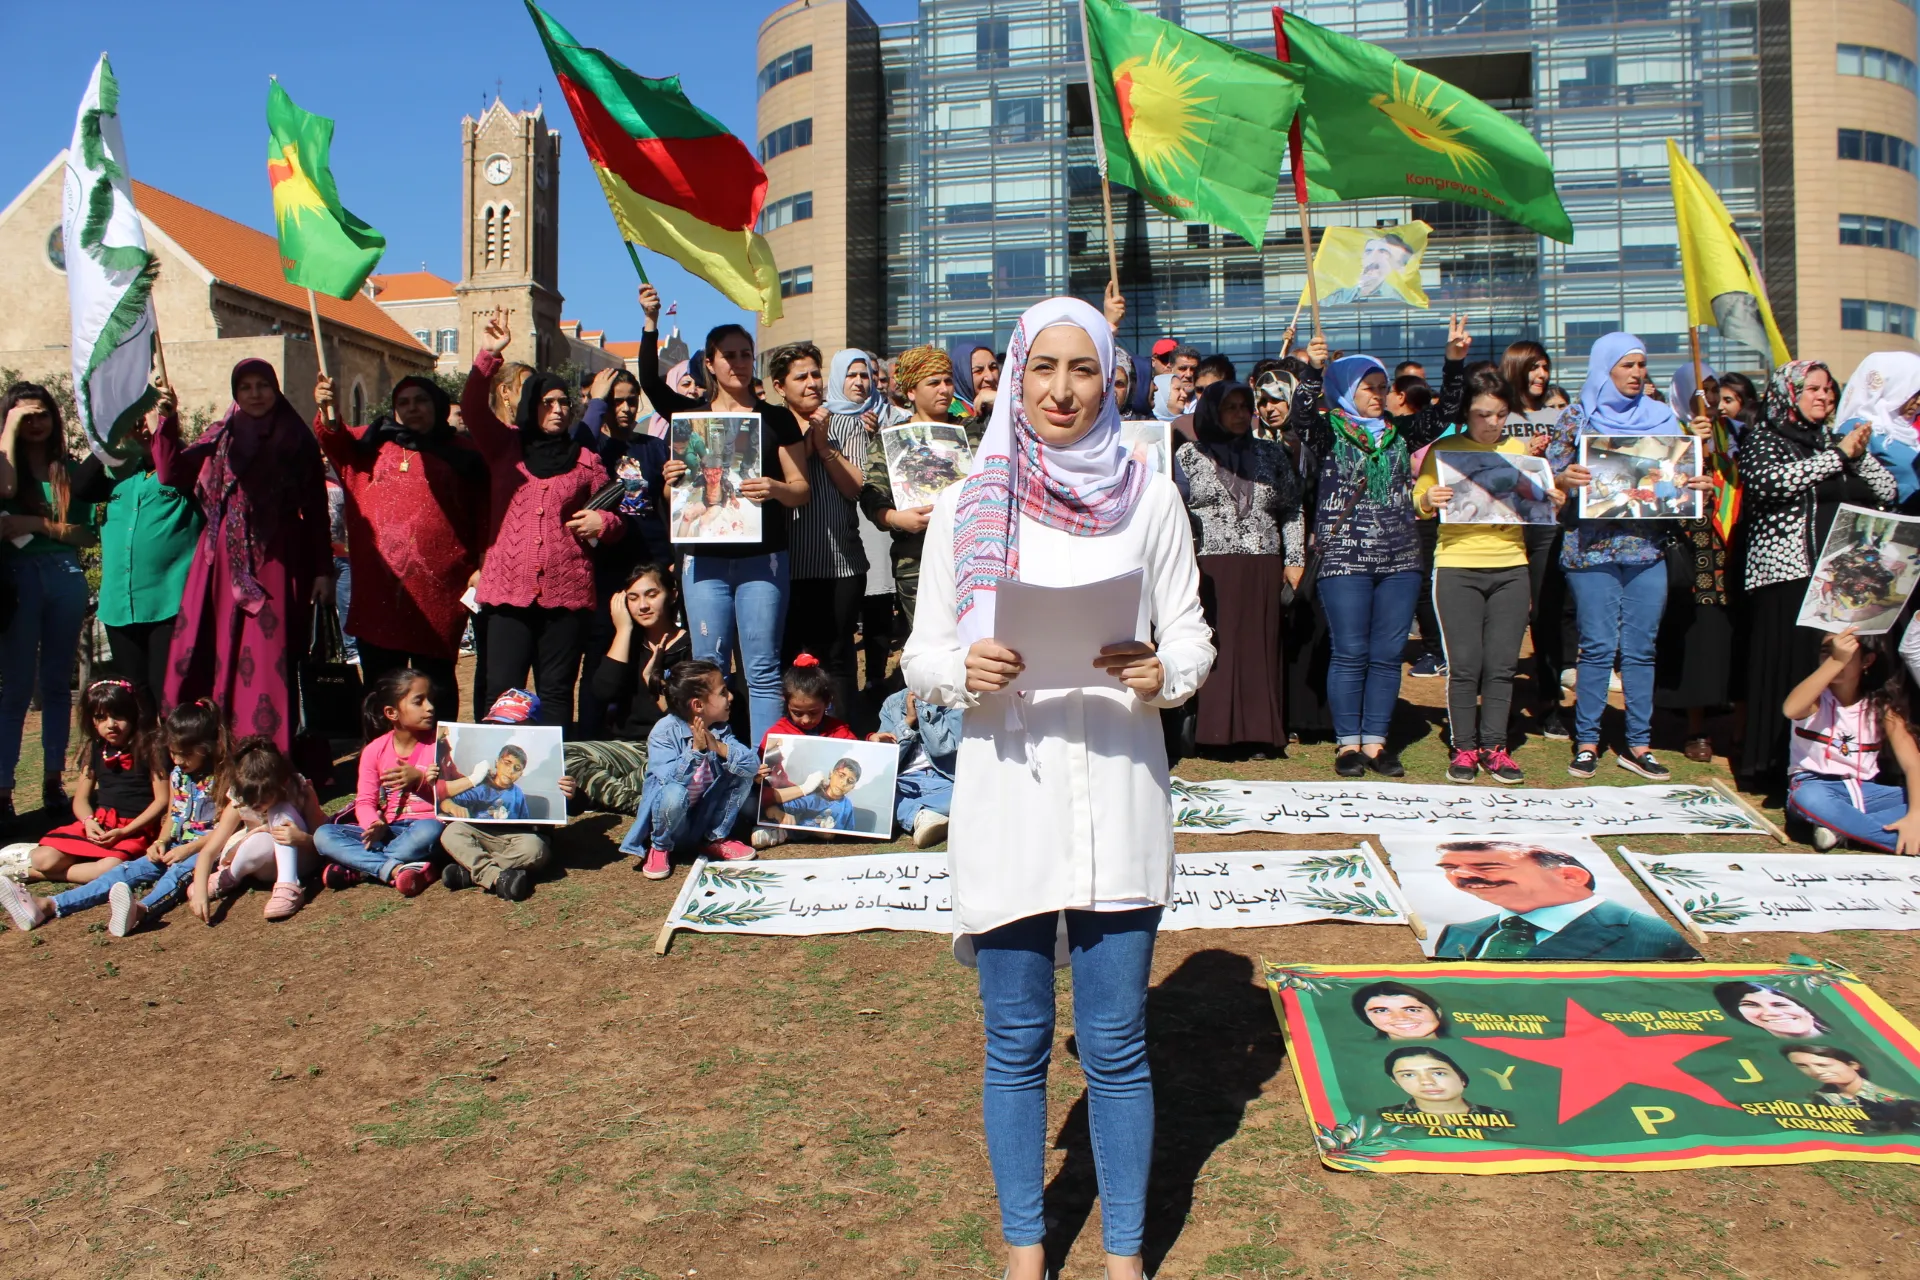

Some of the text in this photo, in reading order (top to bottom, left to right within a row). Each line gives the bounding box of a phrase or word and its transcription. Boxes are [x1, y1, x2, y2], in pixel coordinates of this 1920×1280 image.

[1405, 173, 1479, 196] Kongreya
[1260, 803, 1330, 826] كوباني
[788, 897, 849, 918] سوريا
[1508, 1014, 1551, 1023] ARIN
[1639, 1020, 1704, 1032] XABUR
[1657, 1009, 1725, 1022] AVESTS
[1472, 1021, 1544, 1034] MIRKAN
[1480, 1065, 1516, 1091] Y
[1732, 1058, 1764, 1083] J
[1443, 1113, 1516, 1127] NEWAL
[1630, 1106, 1676, 1135] P
